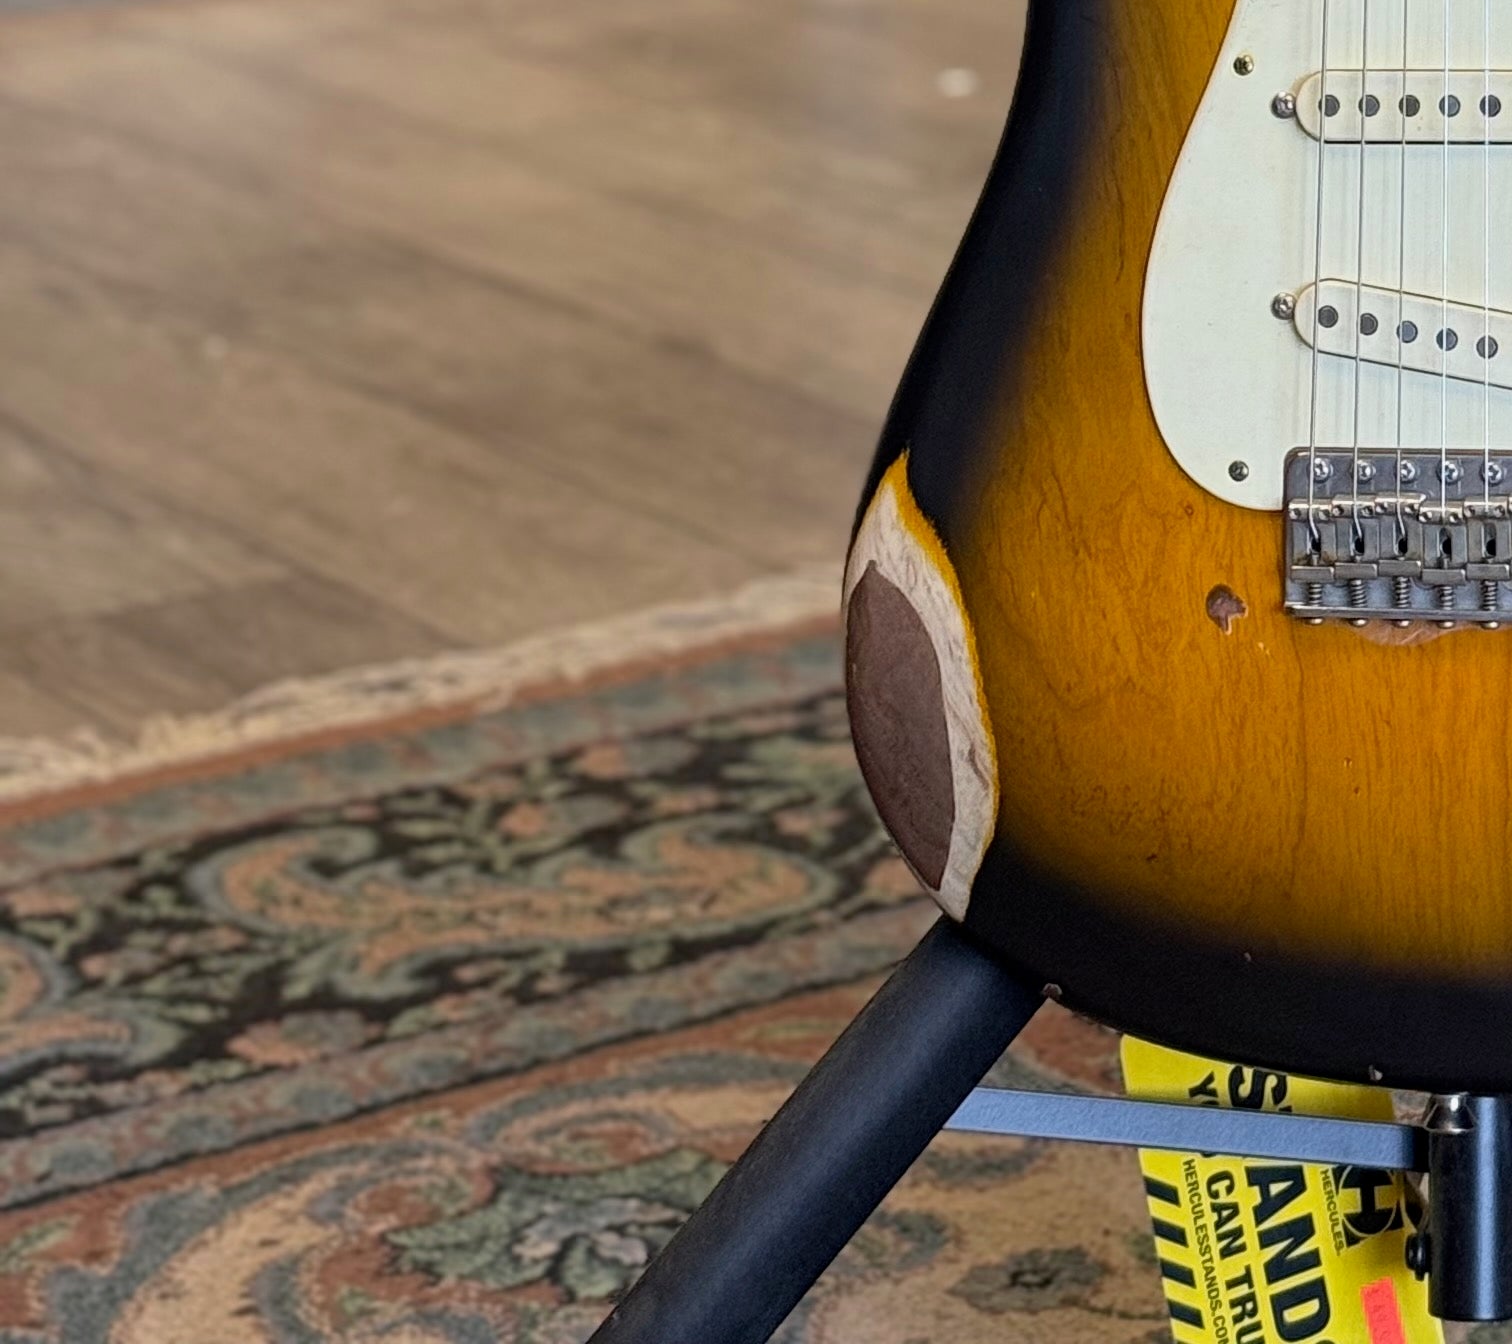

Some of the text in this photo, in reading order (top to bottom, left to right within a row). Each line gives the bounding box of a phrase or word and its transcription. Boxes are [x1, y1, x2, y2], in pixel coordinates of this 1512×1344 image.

[1206, 1170, 1248, 1260] CAN
[1228, 1065, 1335, 1343] SAND
[1320, 1168, 1344, 1253] HERCULES
